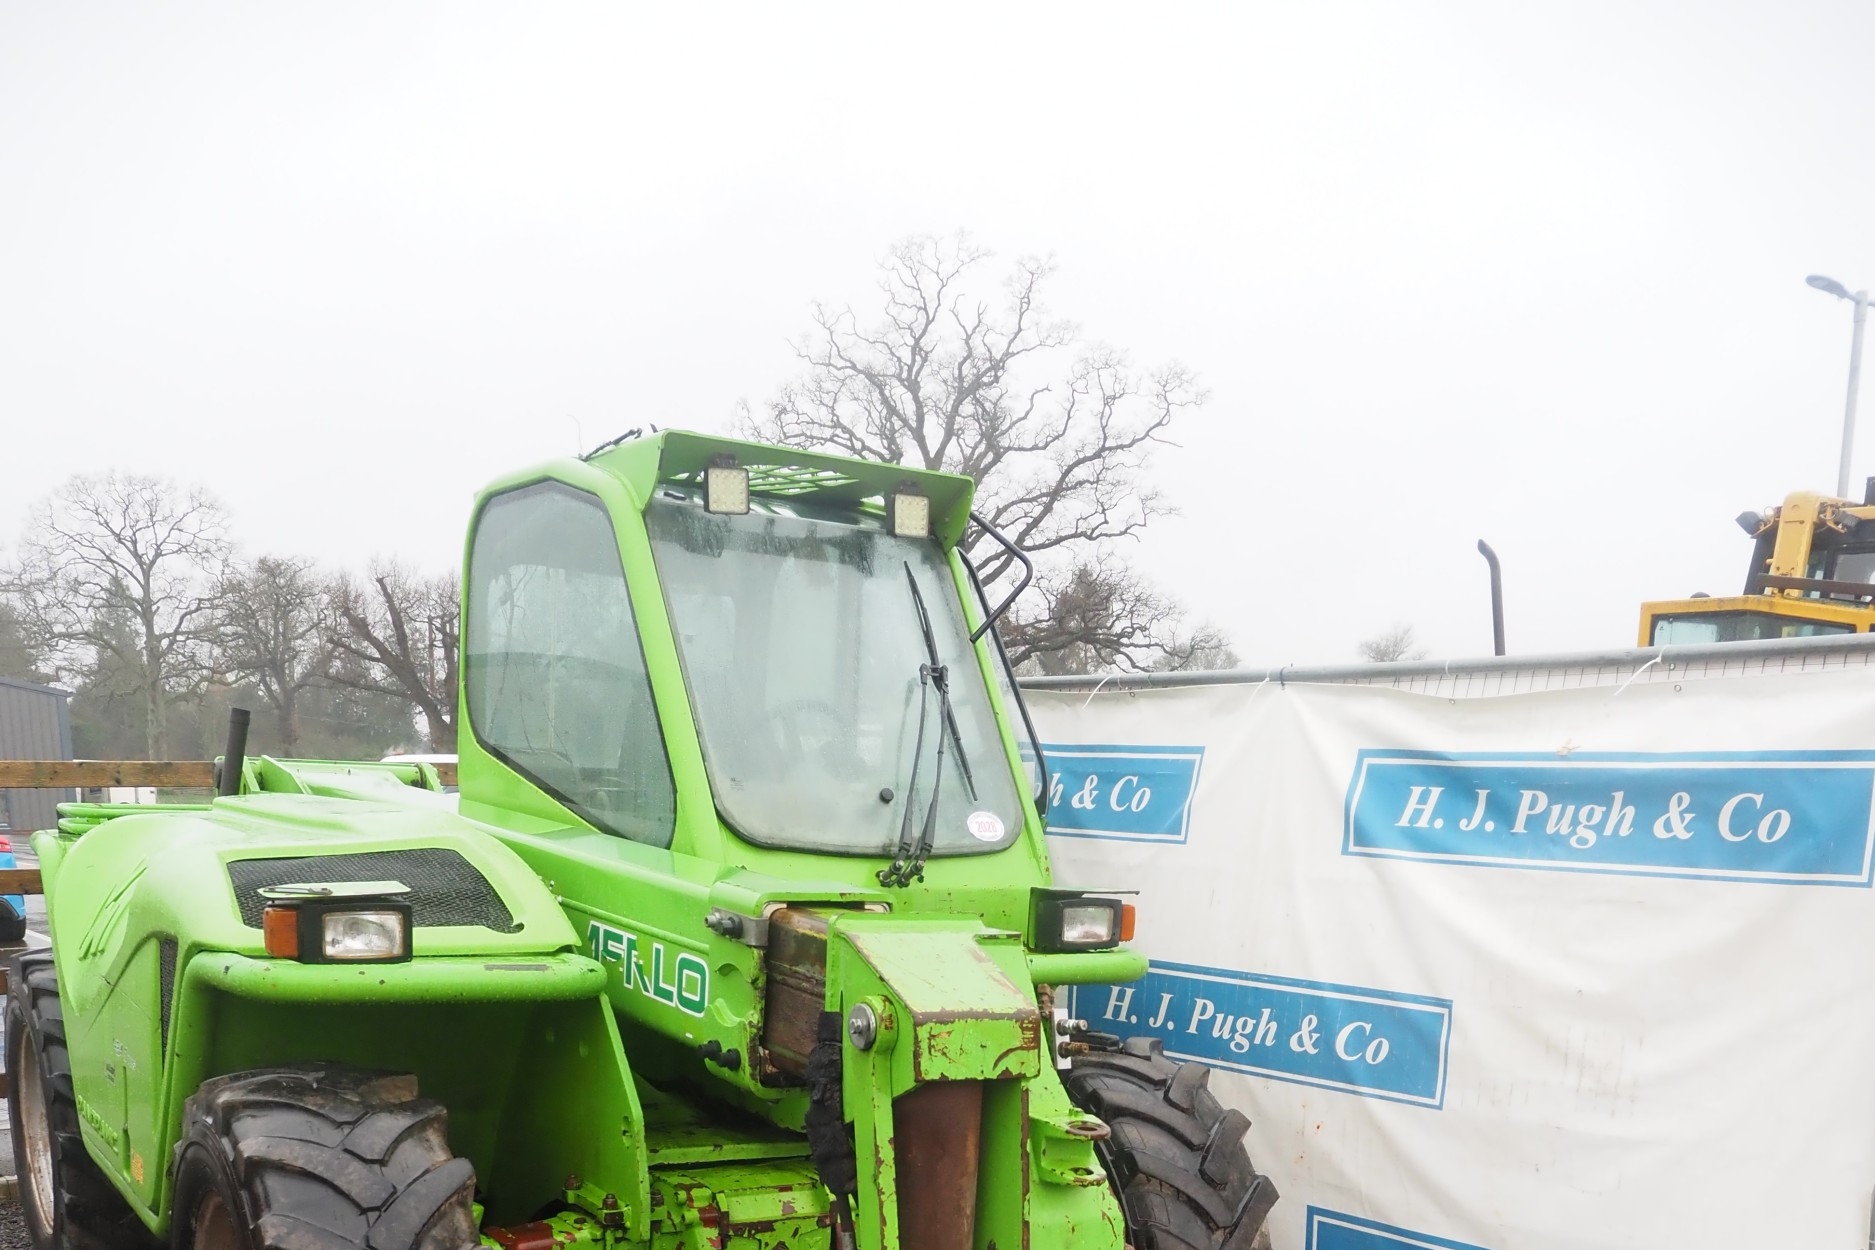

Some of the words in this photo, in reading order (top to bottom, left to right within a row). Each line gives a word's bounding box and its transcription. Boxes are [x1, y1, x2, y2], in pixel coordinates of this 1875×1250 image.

[1071, 774, 1099, 810] &
[1109, 775, 1151, 813] Co
[1394, 785, 1444, 830] H.
[1459, 788, 1496, 832] J.
[1510, 789, 1635, 849] Pugh
[1652, 791, 1697, 840] &
[1717, 792, 1792, 844] Co
[1102, 985, 1138, 1024] H.
[1148, 992, 1175, 1031] J.
[1185, 997, 1278, 1053] Pugh
[1289, 1014, 1322, 1055] &
[1335, 1020, 1390, 1065] Co
